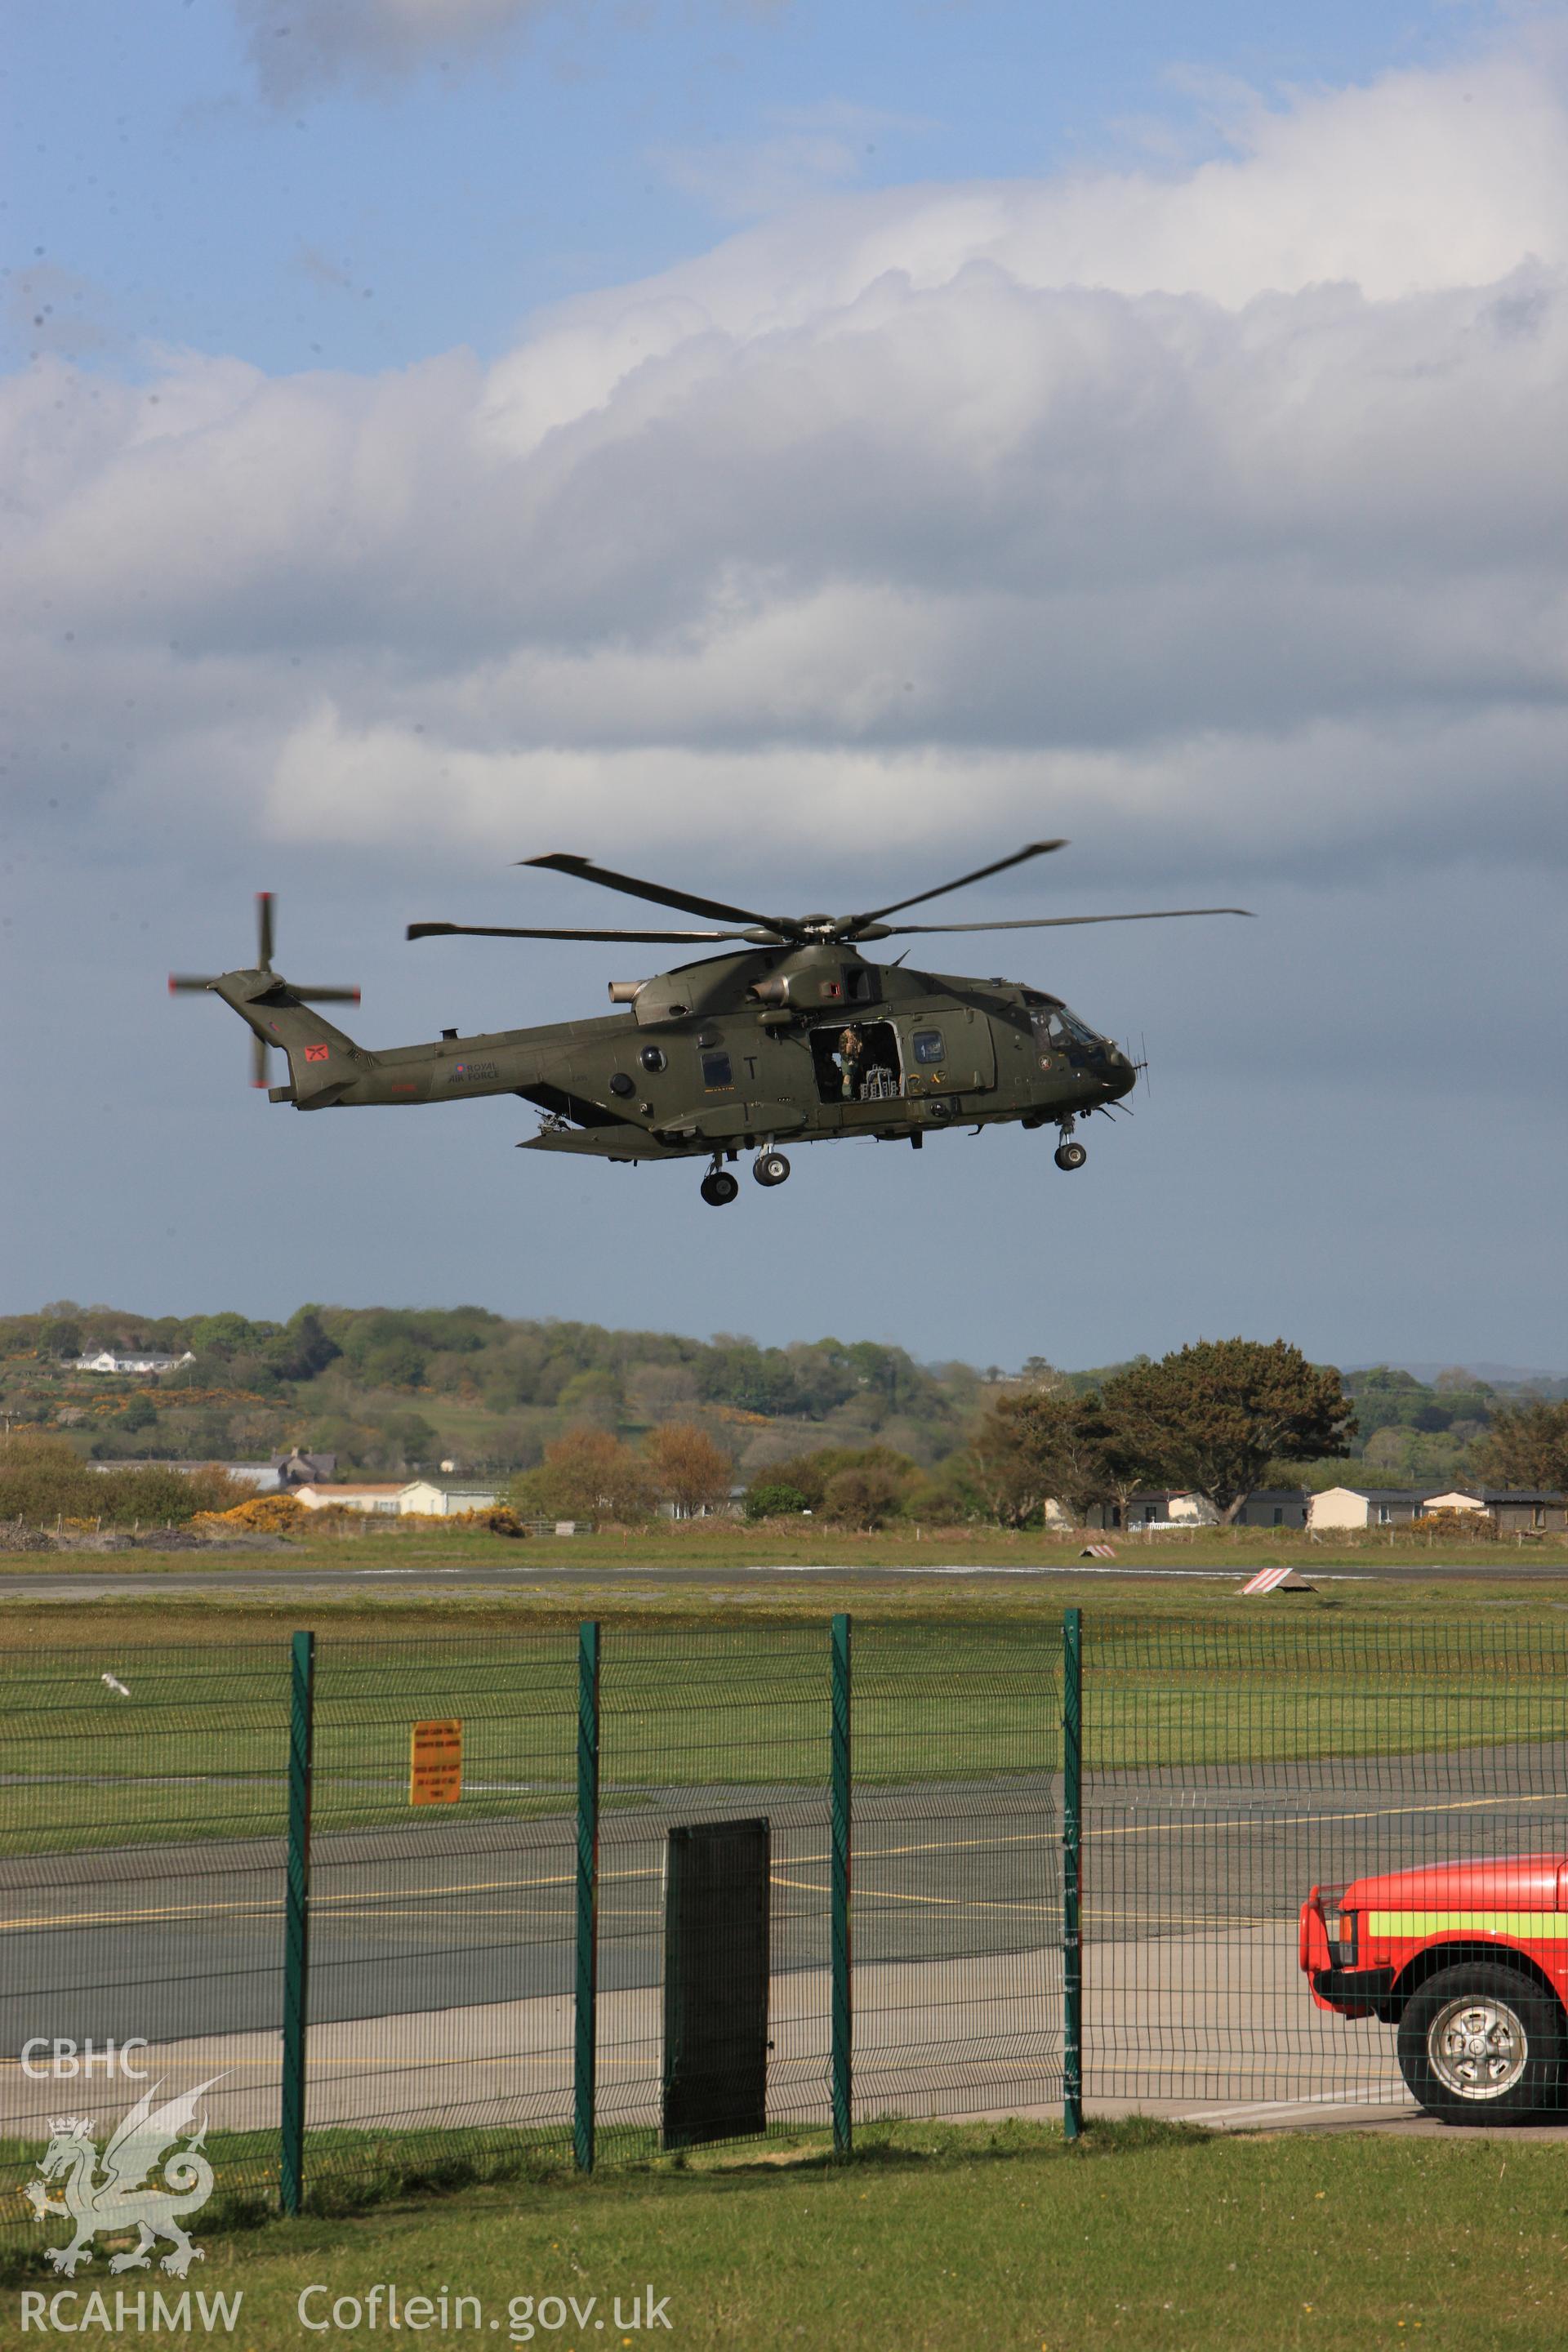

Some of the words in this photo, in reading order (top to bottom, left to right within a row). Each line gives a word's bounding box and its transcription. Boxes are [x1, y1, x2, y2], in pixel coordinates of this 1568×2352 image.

[466, 1062, 497, 1072] ROYAL
[448, 1073, 465, 1083] AIR
[467, 1070, 500, 1081] FORCE
